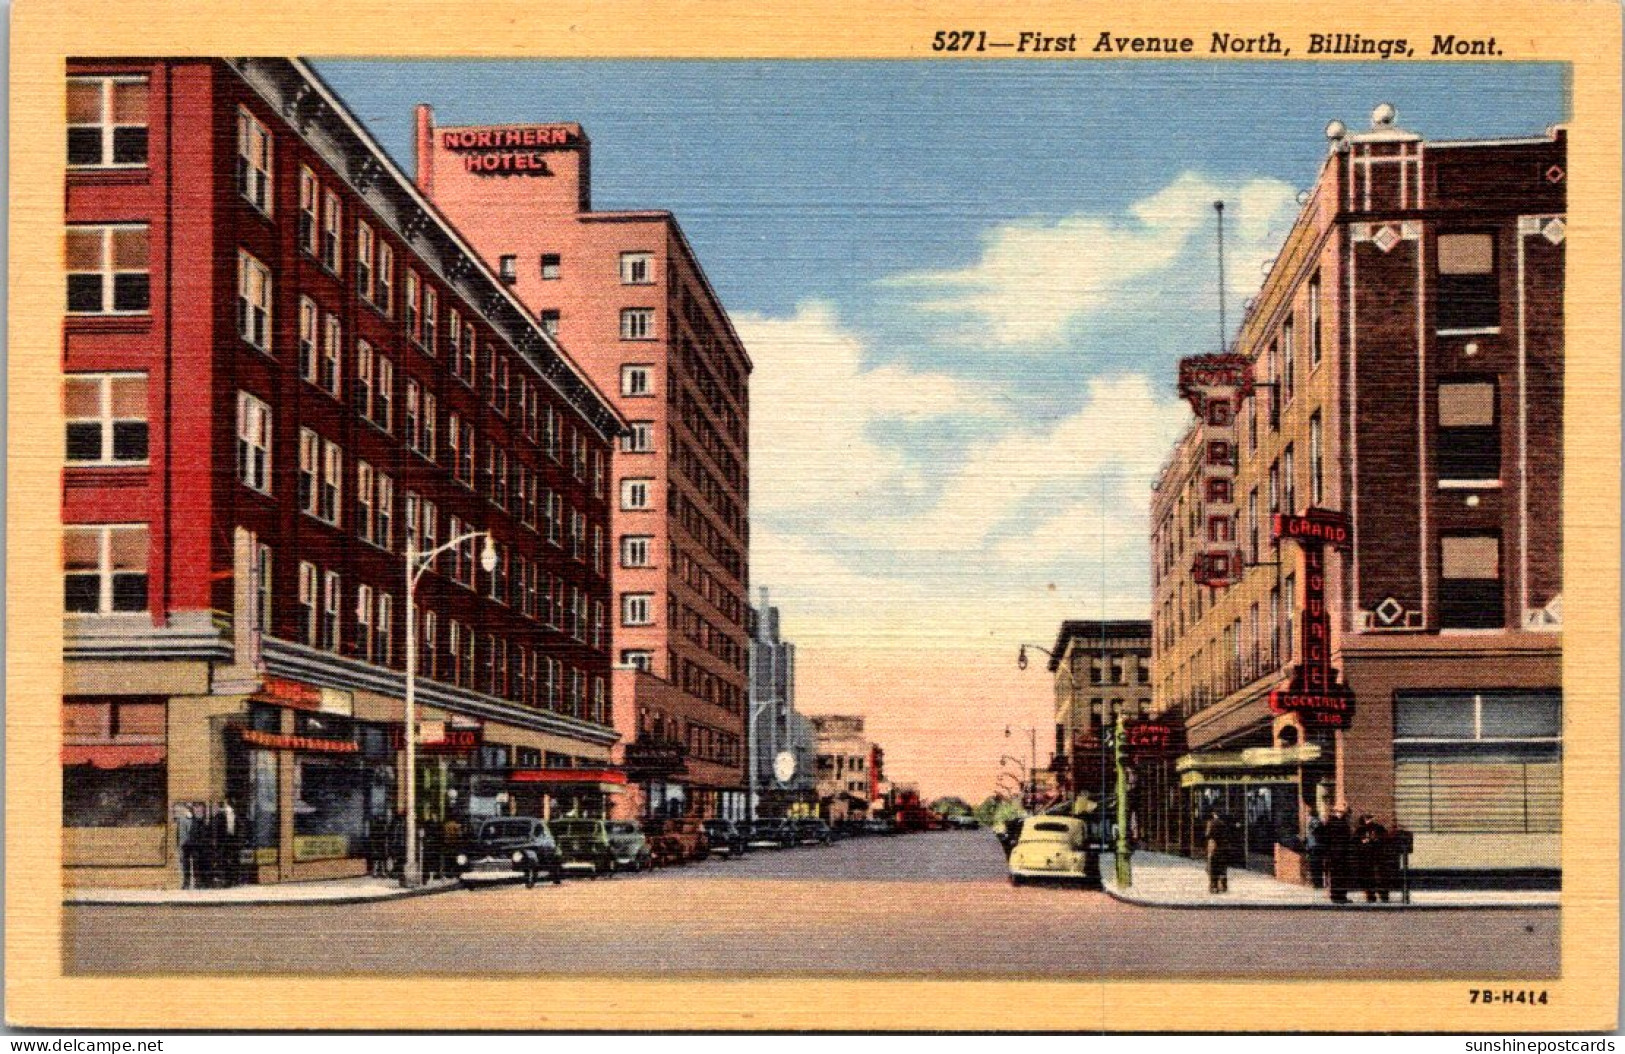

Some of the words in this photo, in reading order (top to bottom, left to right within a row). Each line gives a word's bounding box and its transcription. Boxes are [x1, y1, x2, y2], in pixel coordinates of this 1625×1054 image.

[1093, 32, 1194, 52] Avenue
[1210, 32, 1291, 56] North,
[1307, 34, 1414, 58] Billings,
[1431, 35, 1503, 55] Mont.
[444, 128, 567, 148] NORTHERN
[466, 153, 541, 170] HOTEL
[1469, 990, 1548, 1005] 7B-H414
